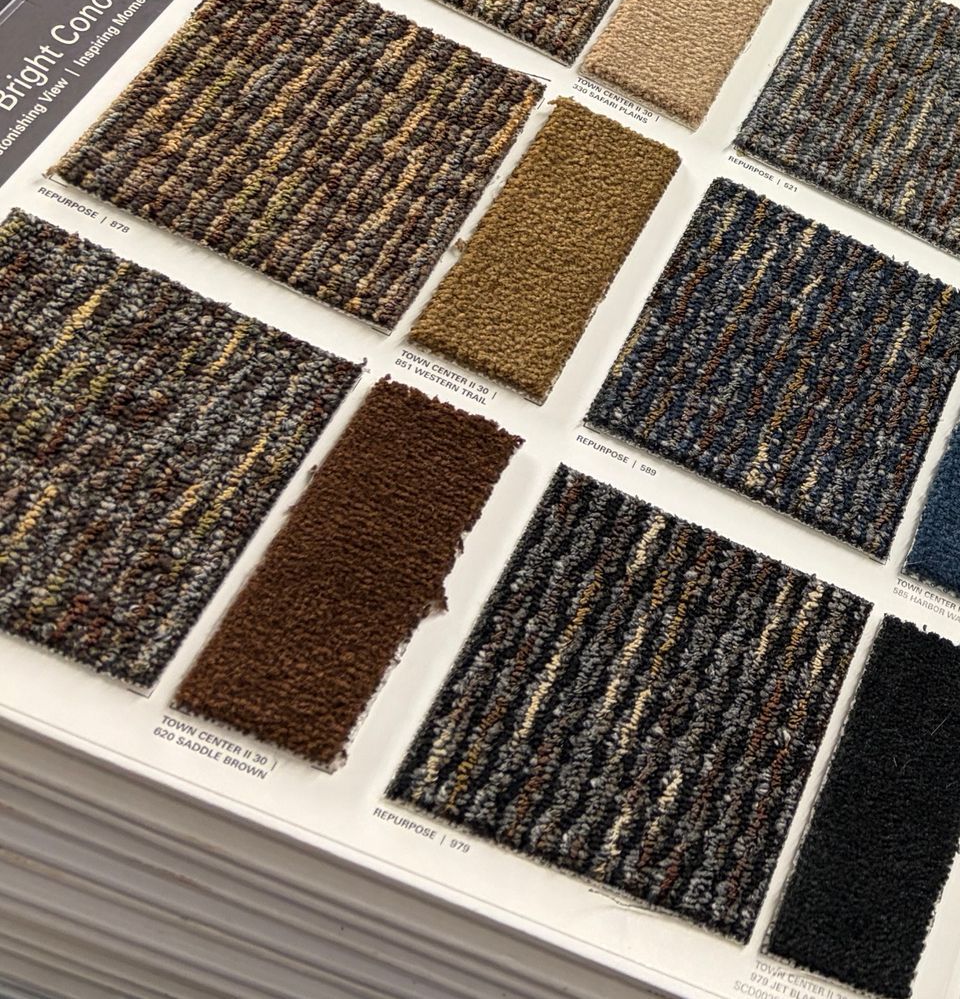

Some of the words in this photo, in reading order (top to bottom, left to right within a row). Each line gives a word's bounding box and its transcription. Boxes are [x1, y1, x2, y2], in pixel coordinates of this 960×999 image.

[0, 44, 64, 112] Bright
[38, 78, 69, 103] View
[76, 26, 119, 68] Inspiring
[572, 84, 588, 94] 330
[589, 91, 618, 109] SAFARI
[619, 106, 648, 124] PLAINS
[578, 77, 603, 93] TOWN
[604, 90, 635, 109] CENTER
[642, 109, 653, 118] 30
[728, 156, 775, 181] REPURPOSE
[38, 187, 99, 219] REPURPOSE
[110, 221, 130, 234] 878
[395, 358, 412, 370] 851
[415, 367, 460, 392] WESTERN
[462, 388, 487, 405] TRAIL
[402, 350, 431, 368] TOWN
[432, 364, 468, 385] CENTER
[477, 385, 489, 395] 30
[576, 435, 630, 464] REPURPOSE
[640, 465, 657, 477] 589
[893, 587, 908, 599] 585
[910, 595, 945, 618] HARBOR
[897, 578, 923, 594] TOWN
[924, 591, 957, 610] CENTER
[153, 727, 175, 741] 620
[176, 736, 223, 761] SADDLE
[223, 755, 267, 780] BROWN
[162, 716, 198, 736] TOWN
[198, 731, 242, 756] CENTER
[243, 750, 251, 759] II
[253, 755, 268, 766] 30
[373, 808, 437, 840] REPURPOSE
[450, 840, 471, 854] 979
[751, 973, 769, 986] 979
[770, 982, 788, 994] JET
[756, 961, 786, 978] TOWN
[788, 974, 825, 996] CENTER
